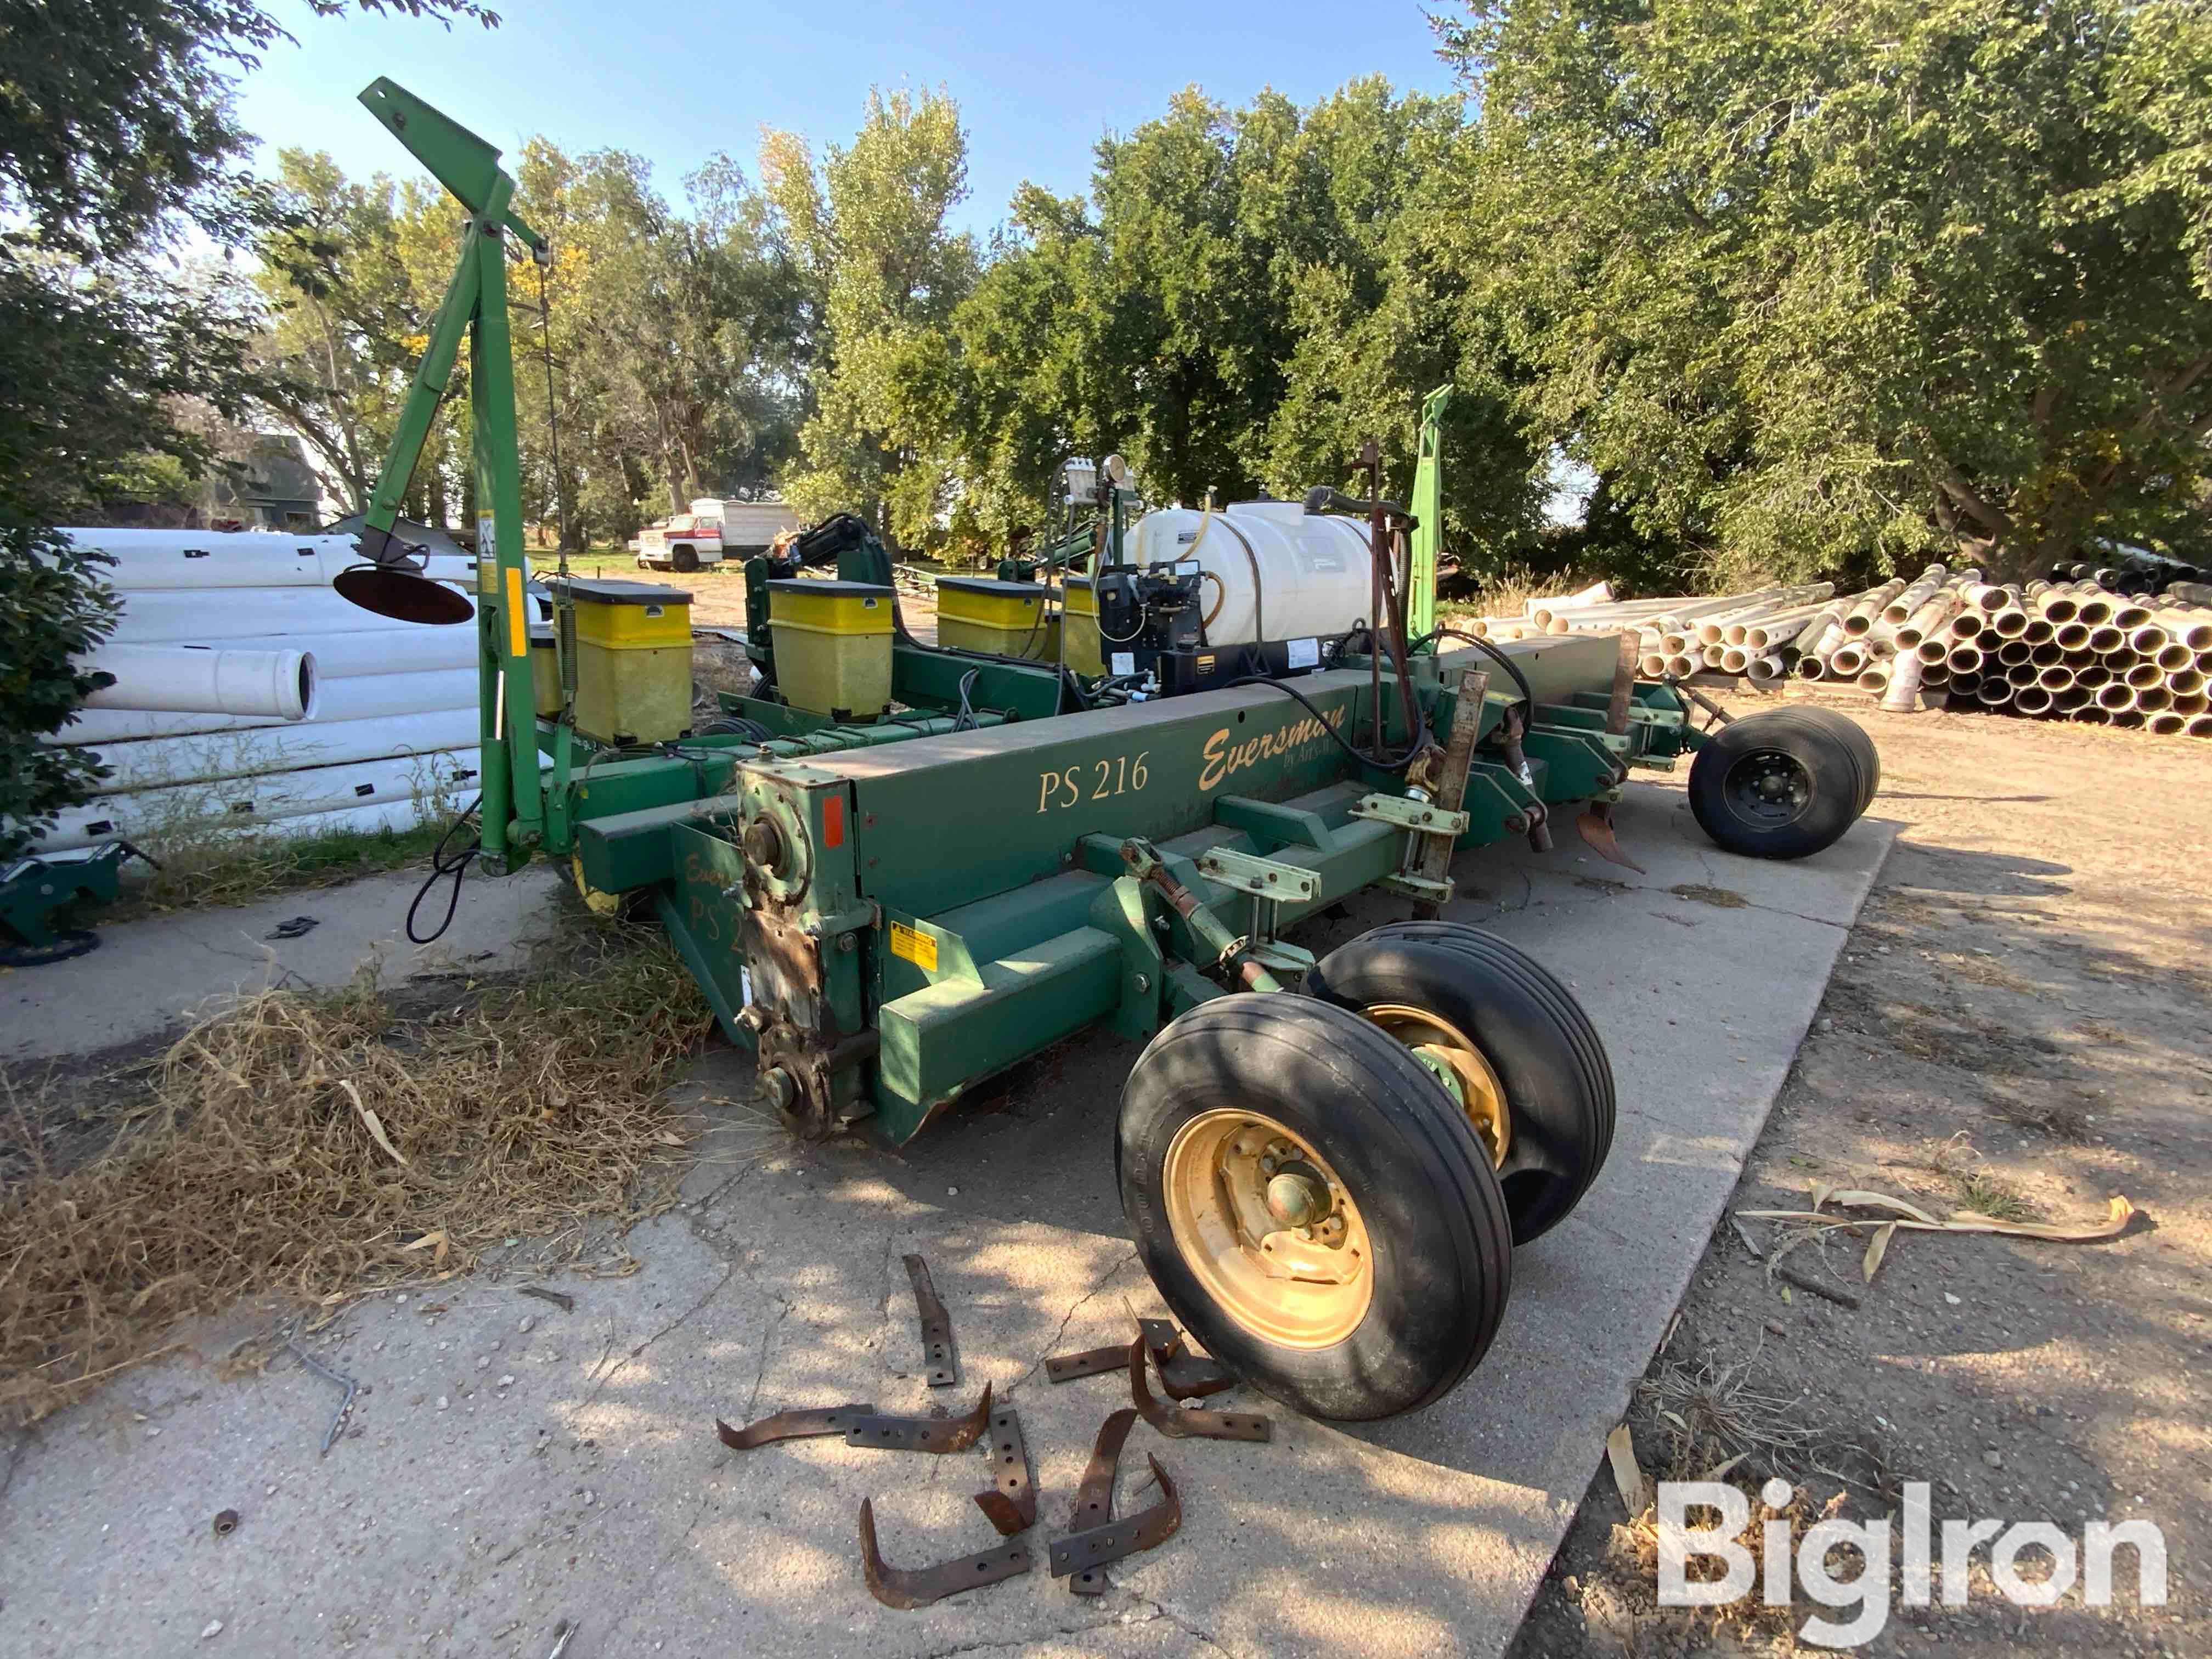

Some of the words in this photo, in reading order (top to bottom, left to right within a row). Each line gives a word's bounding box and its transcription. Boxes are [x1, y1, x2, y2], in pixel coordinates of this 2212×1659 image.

[1198, 703, 1345, 791] Eversman
[1037, 766, 1080, 814] PS
[1092, 751, 1149, 800] 216
[690, 895, 720, 940] PS
